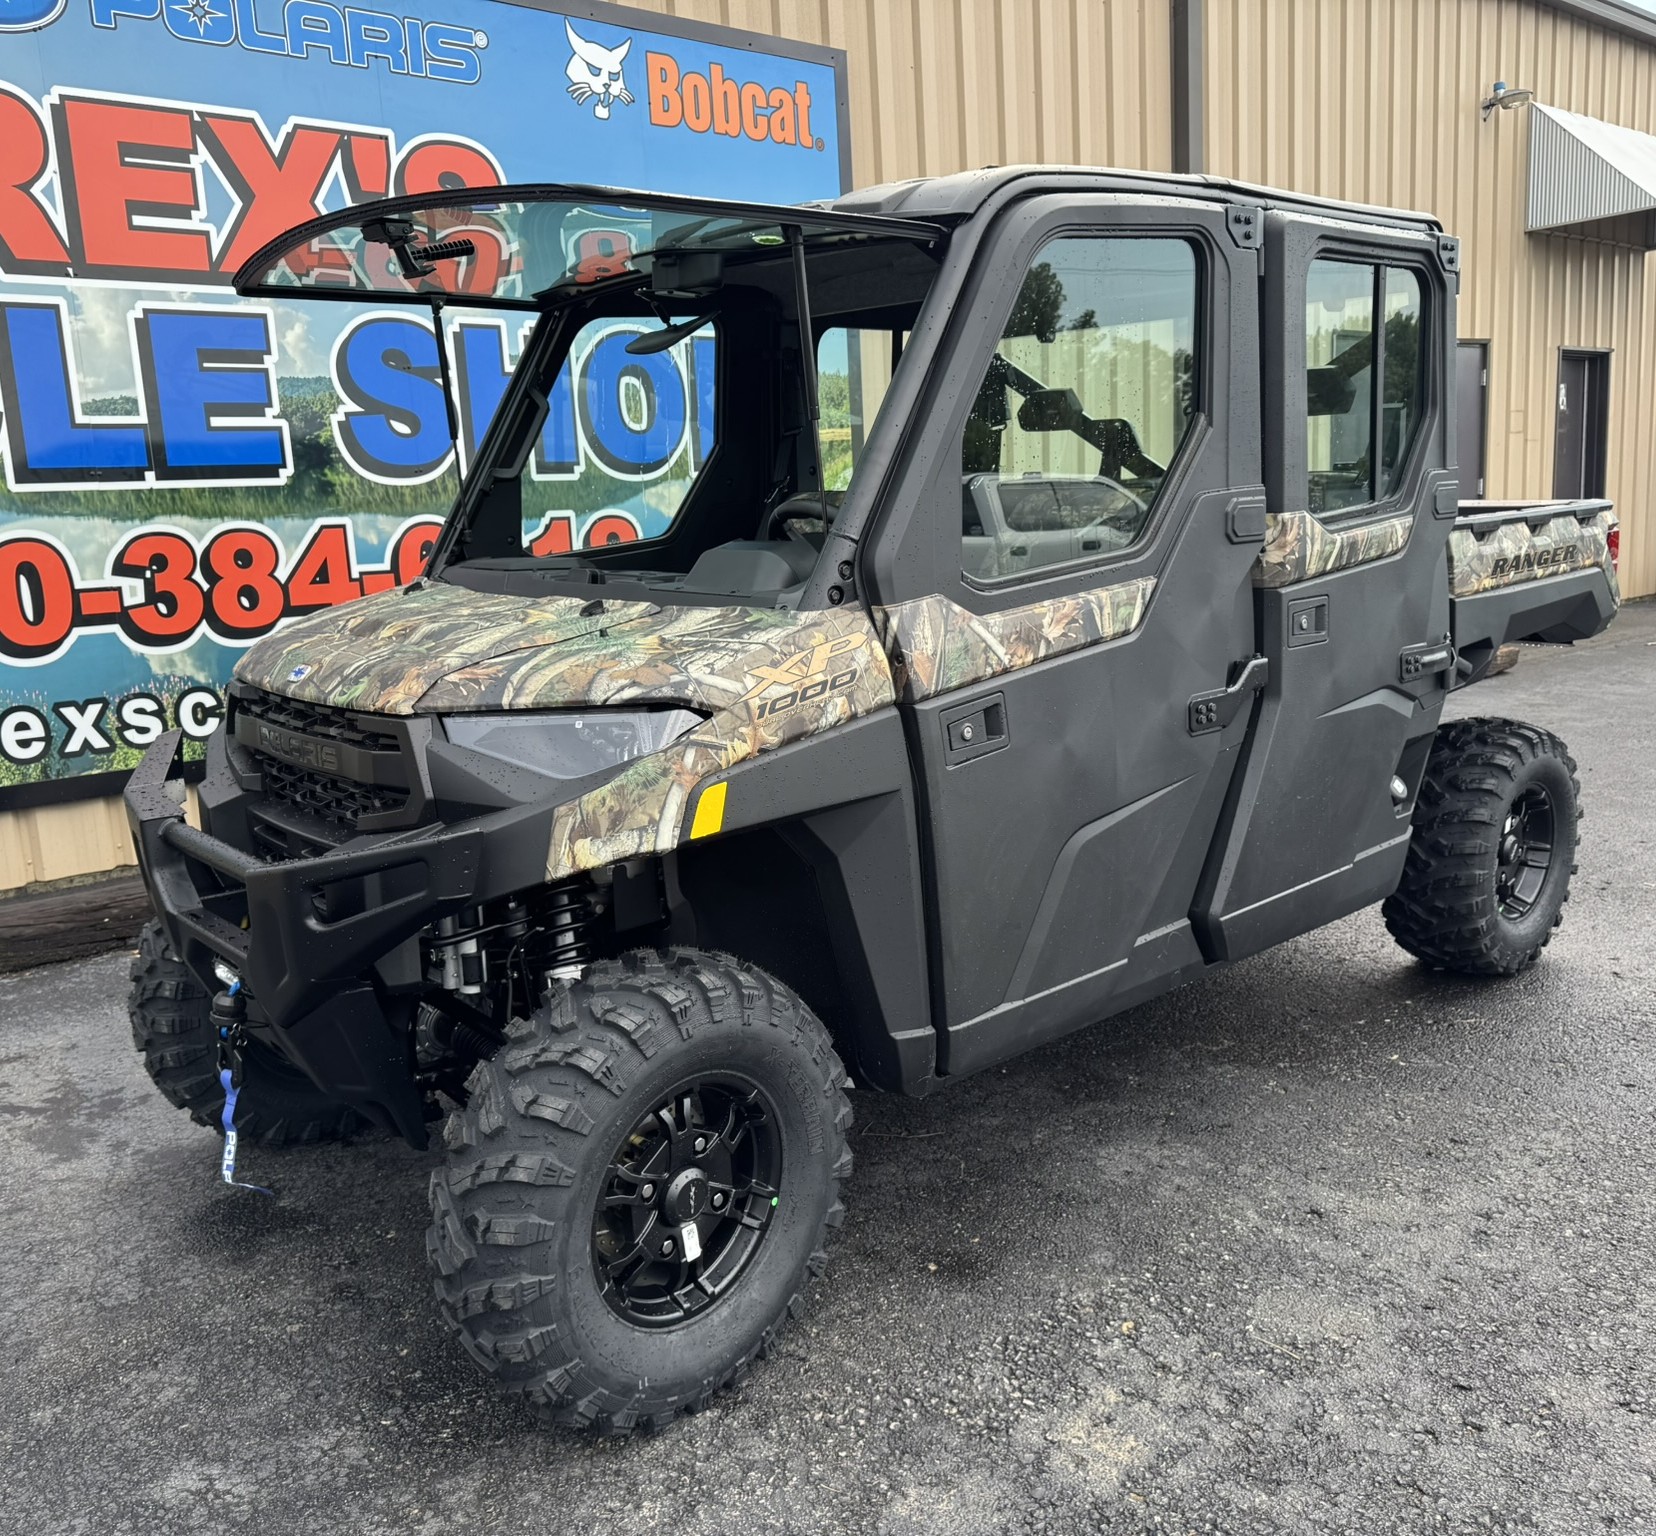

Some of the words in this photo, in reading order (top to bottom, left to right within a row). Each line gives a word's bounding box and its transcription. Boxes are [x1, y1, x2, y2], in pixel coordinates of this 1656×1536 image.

[645, 50, 814, 149] Bobcat
[335, 314, 716, 478] SHO
[1491, 544, 1578, 578] RANGER
[729, 631, 868, 706] XP
[756, 667, 859, 721] 1000
[259, 726, 338, 770] POLARIS
